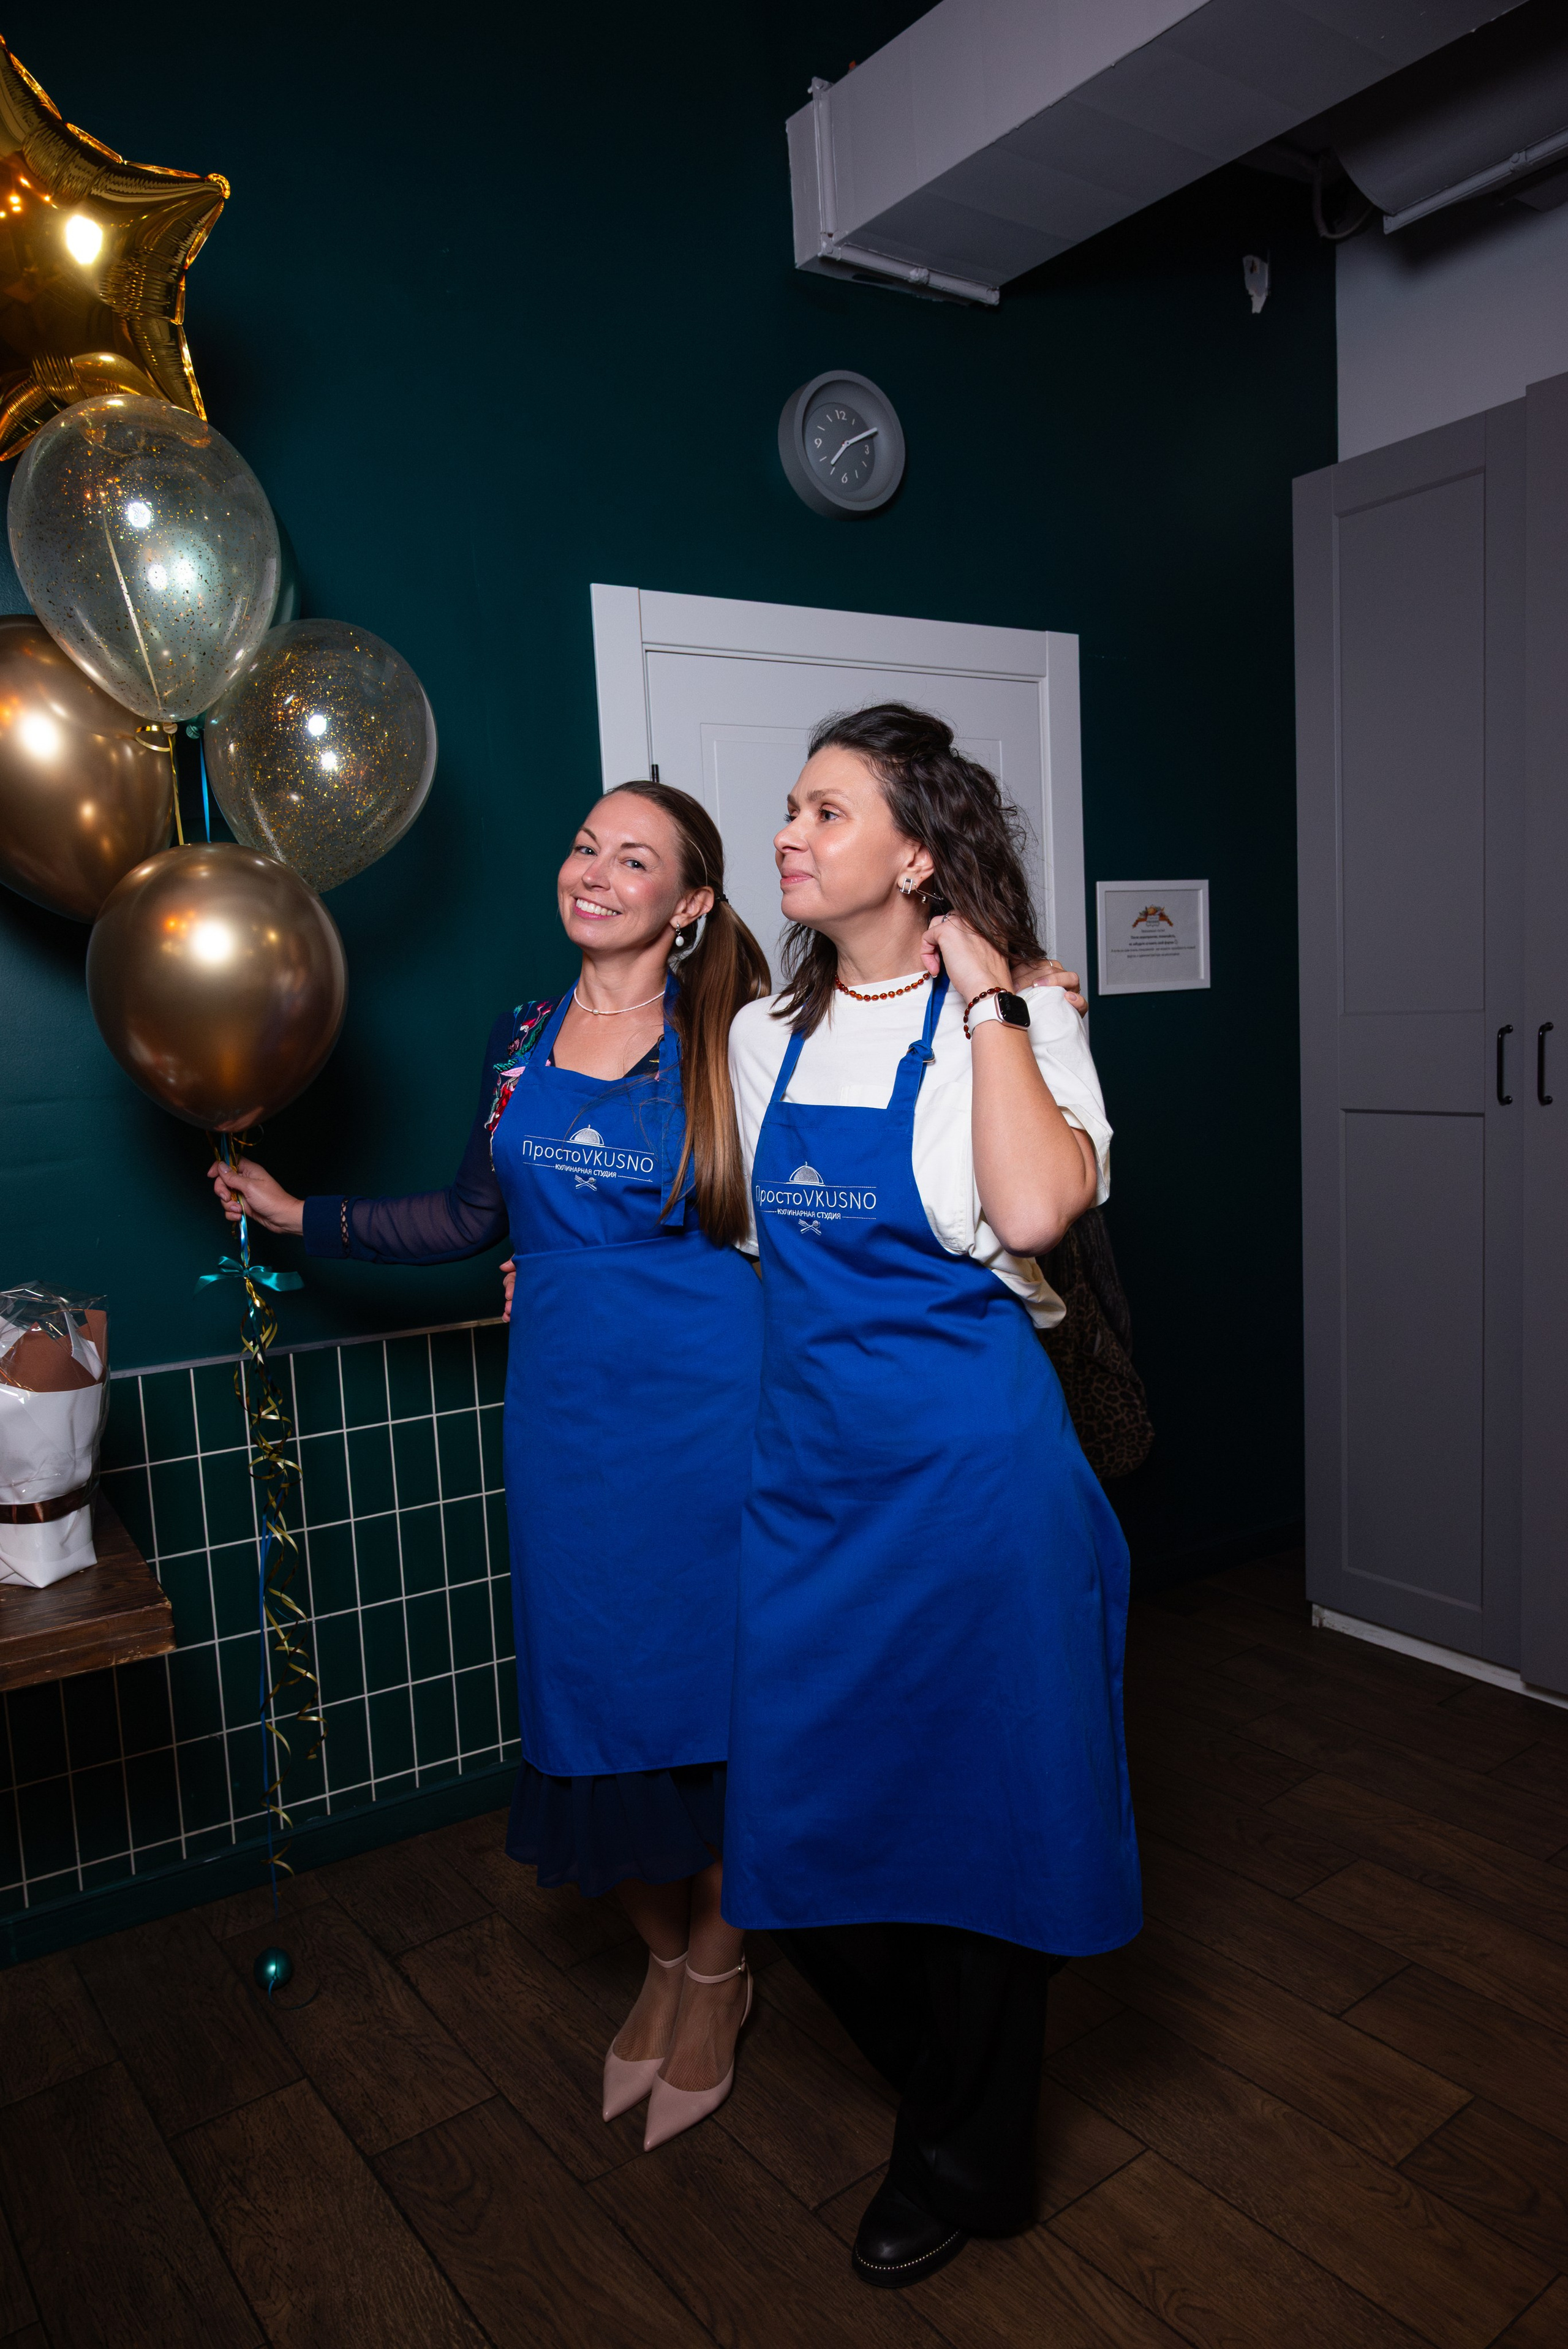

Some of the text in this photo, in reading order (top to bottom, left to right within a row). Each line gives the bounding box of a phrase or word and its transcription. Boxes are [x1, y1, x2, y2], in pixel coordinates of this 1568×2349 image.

[834, 409, 847, 421] 12
[814, 437, 823, 448] 9
[864, 445, 870, 455] 3
[841, 472, 848, 484] 6
[522, 1140, 654, 1173] ПростоVKUSNO
[555, 1163, 617, 1178] КУЛИНАРНАЯ СТУДИЯ
[777, 1208, 842, 1221] КУЛИНАРНАЯ СТУДИЯ
